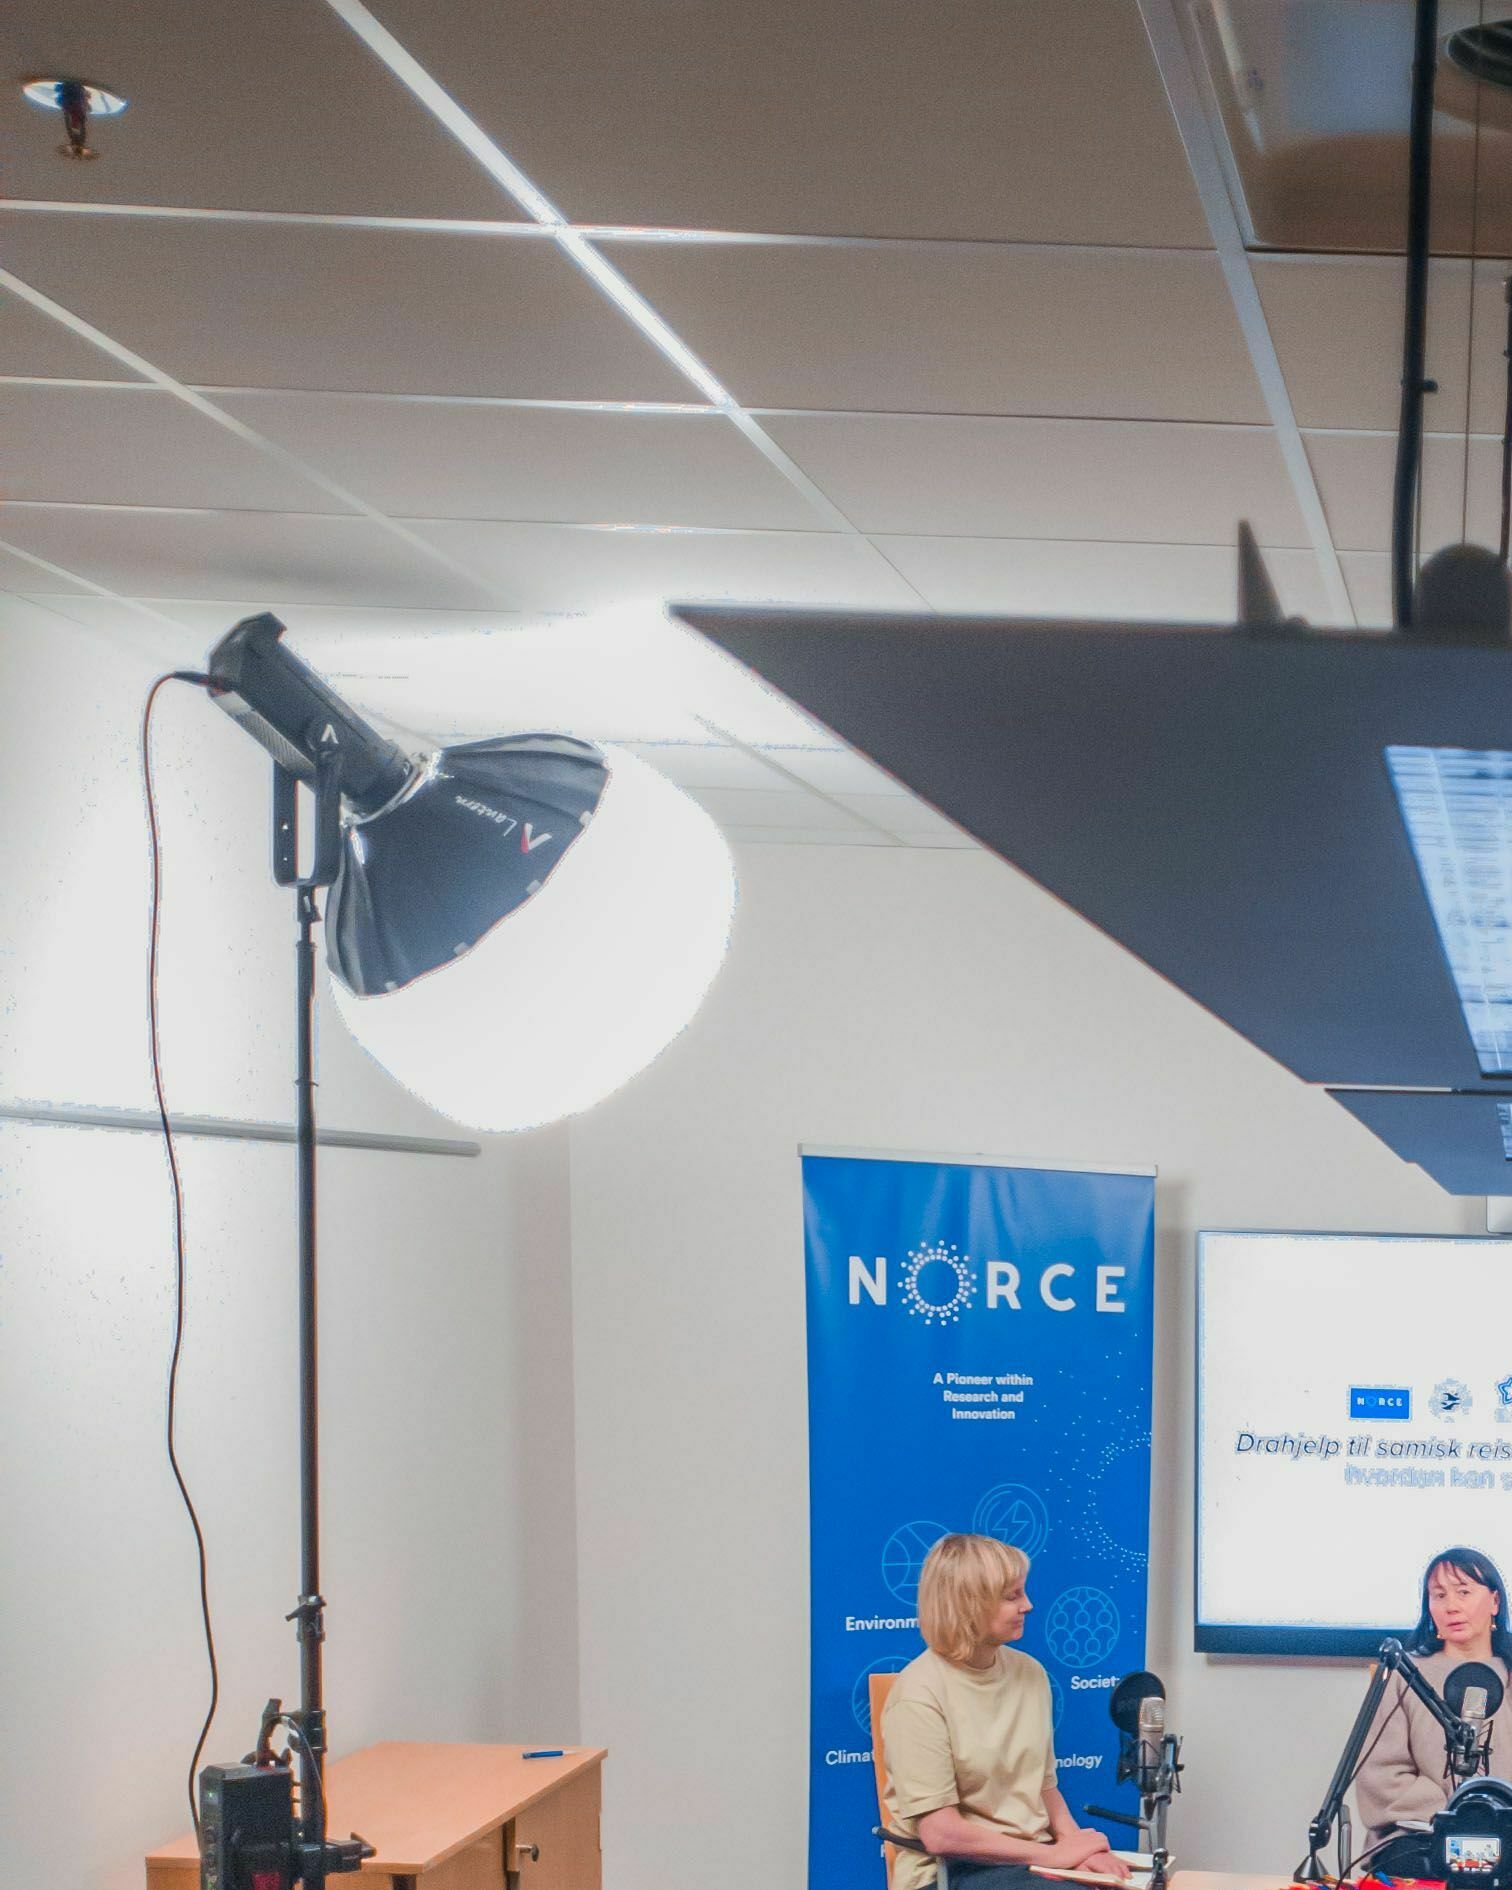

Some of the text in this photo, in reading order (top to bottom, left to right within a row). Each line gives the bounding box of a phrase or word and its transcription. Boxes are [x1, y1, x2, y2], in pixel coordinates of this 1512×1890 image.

[848, 1239, 1127, 1326] NORCE
[932, 1372, 1034, 1386] A Pioneer within
[943, 1389, 1025, 1403] Research and
[952, 1407, 1016, 1420] Innovation
[1237, 1432, 1340, 1459] Drahjelp
[1348, 1434, 1373, 1456] til
[1376, 1436, 1463, 1459] samisk
[845, 1614, 920, 1632] Environm
[1070, 1674, 1121, 1690] Societ
[825, 1749, 873, 1766] Clima
[1055, 1753, 1103, 1769] nology
